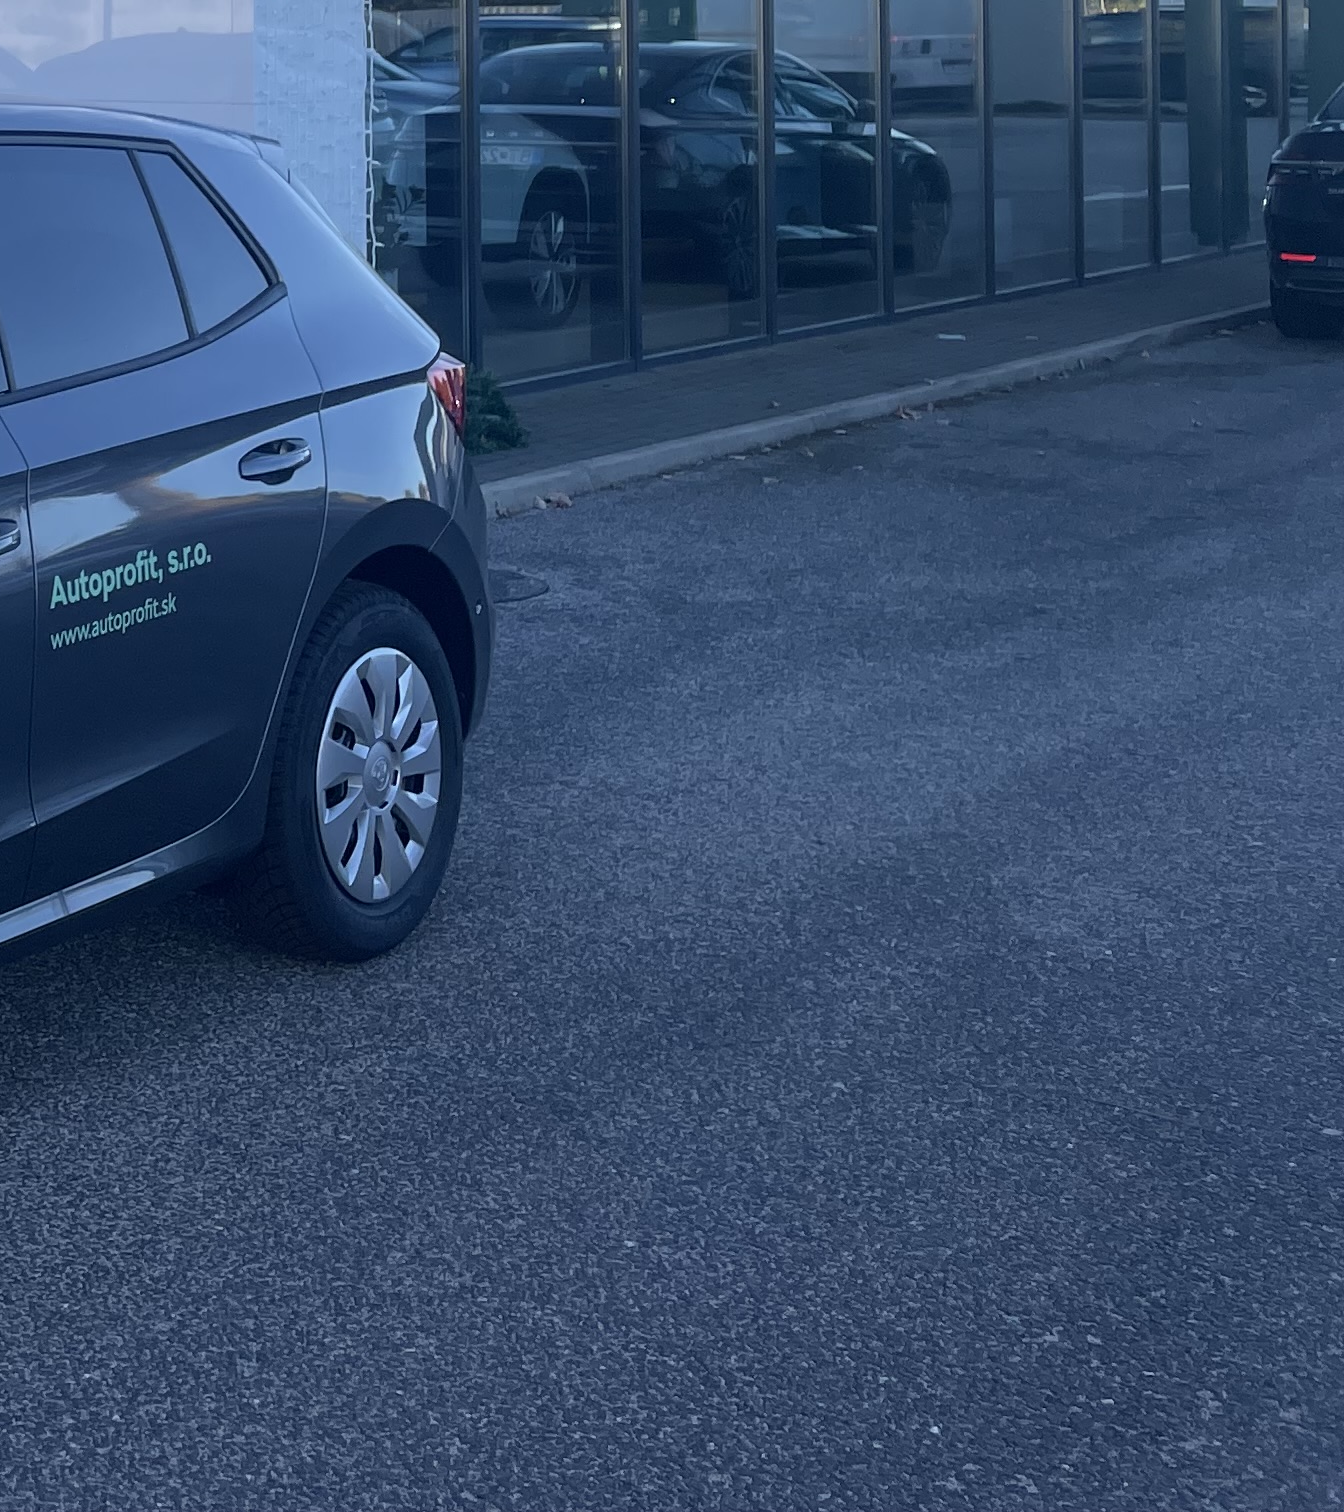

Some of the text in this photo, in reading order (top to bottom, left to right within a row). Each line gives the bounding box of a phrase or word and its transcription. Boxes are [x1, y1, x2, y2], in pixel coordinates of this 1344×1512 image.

[49, 542, 212, 609] Autoprofit, s.r.o.
[50, 591, 178, 650] www.autoprofit.sk
